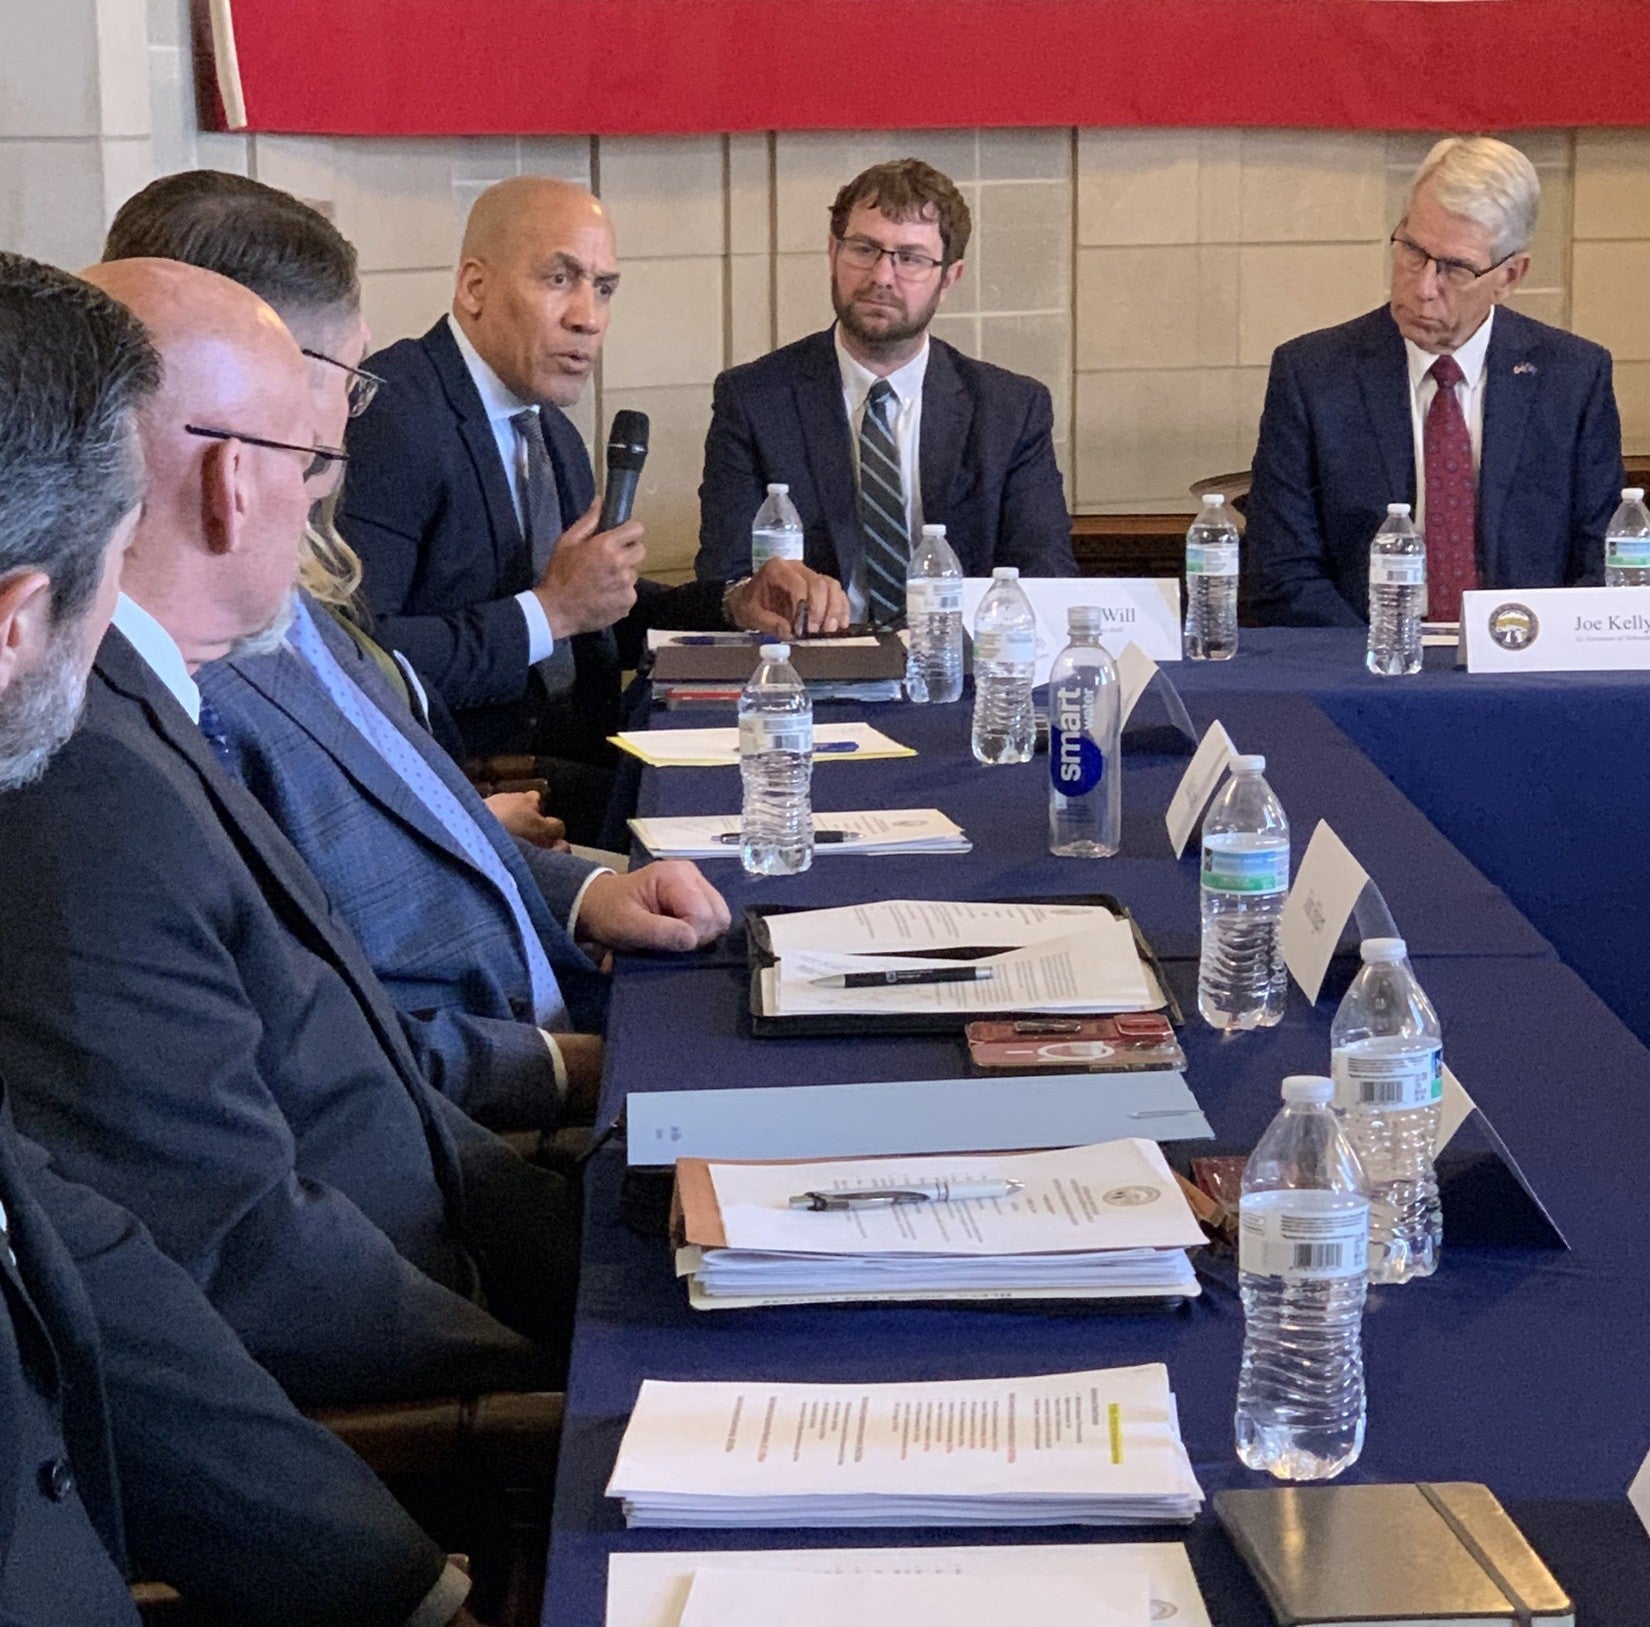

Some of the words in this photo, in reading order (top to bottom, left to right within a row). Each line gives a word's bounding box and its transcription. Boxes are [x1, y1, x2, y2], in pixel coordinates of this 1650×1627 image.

[1101, 608, 1135, 622] Will
[1575, 616, 1602, 631] Joe
[1083, 687, 1095, 730] water
[1058, 687, 1081, 782] smart
